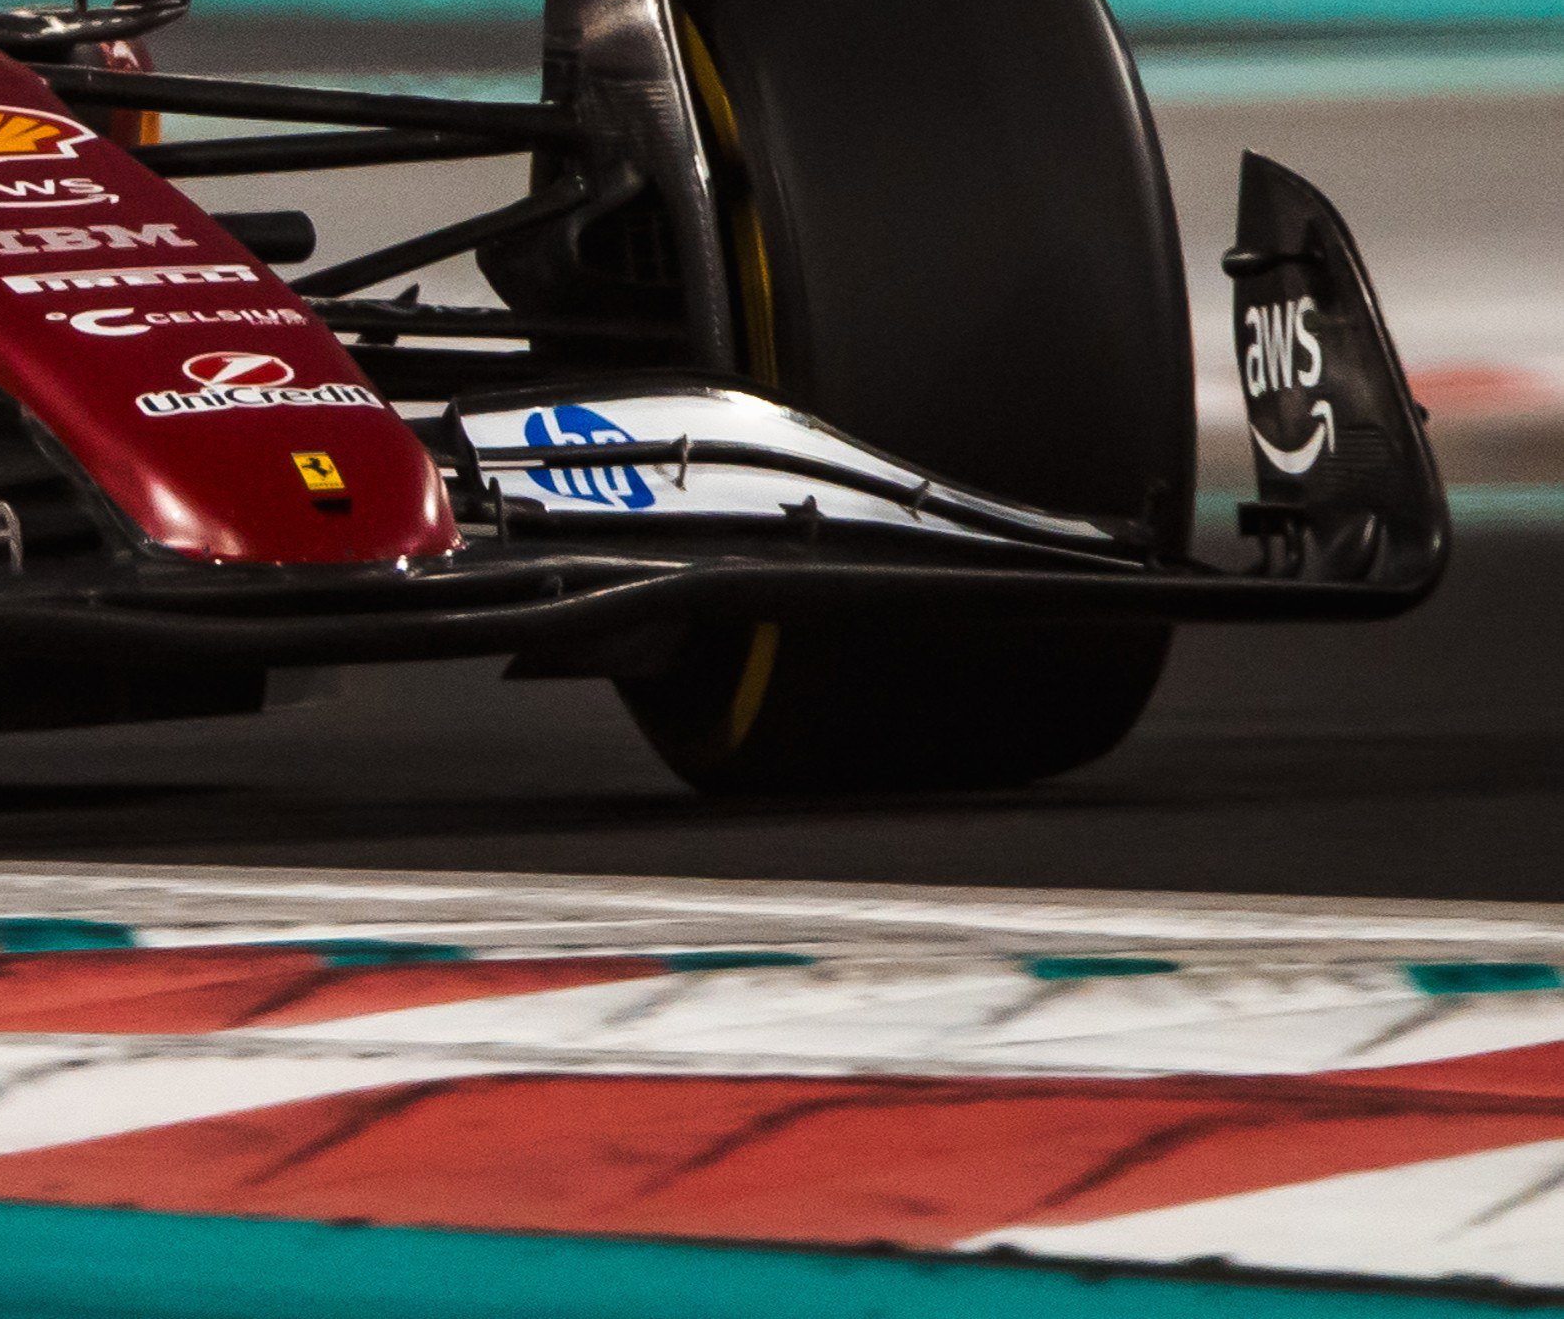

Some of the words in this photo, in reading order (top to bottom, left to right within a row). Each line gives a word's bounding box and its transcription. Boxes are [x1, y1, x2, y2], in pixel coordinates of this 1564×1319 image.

[0, 264, 261, 294] PIRELLI
[1245, 296, 1323, 397] aws
[135, 382, 385, 418] UniCredit
